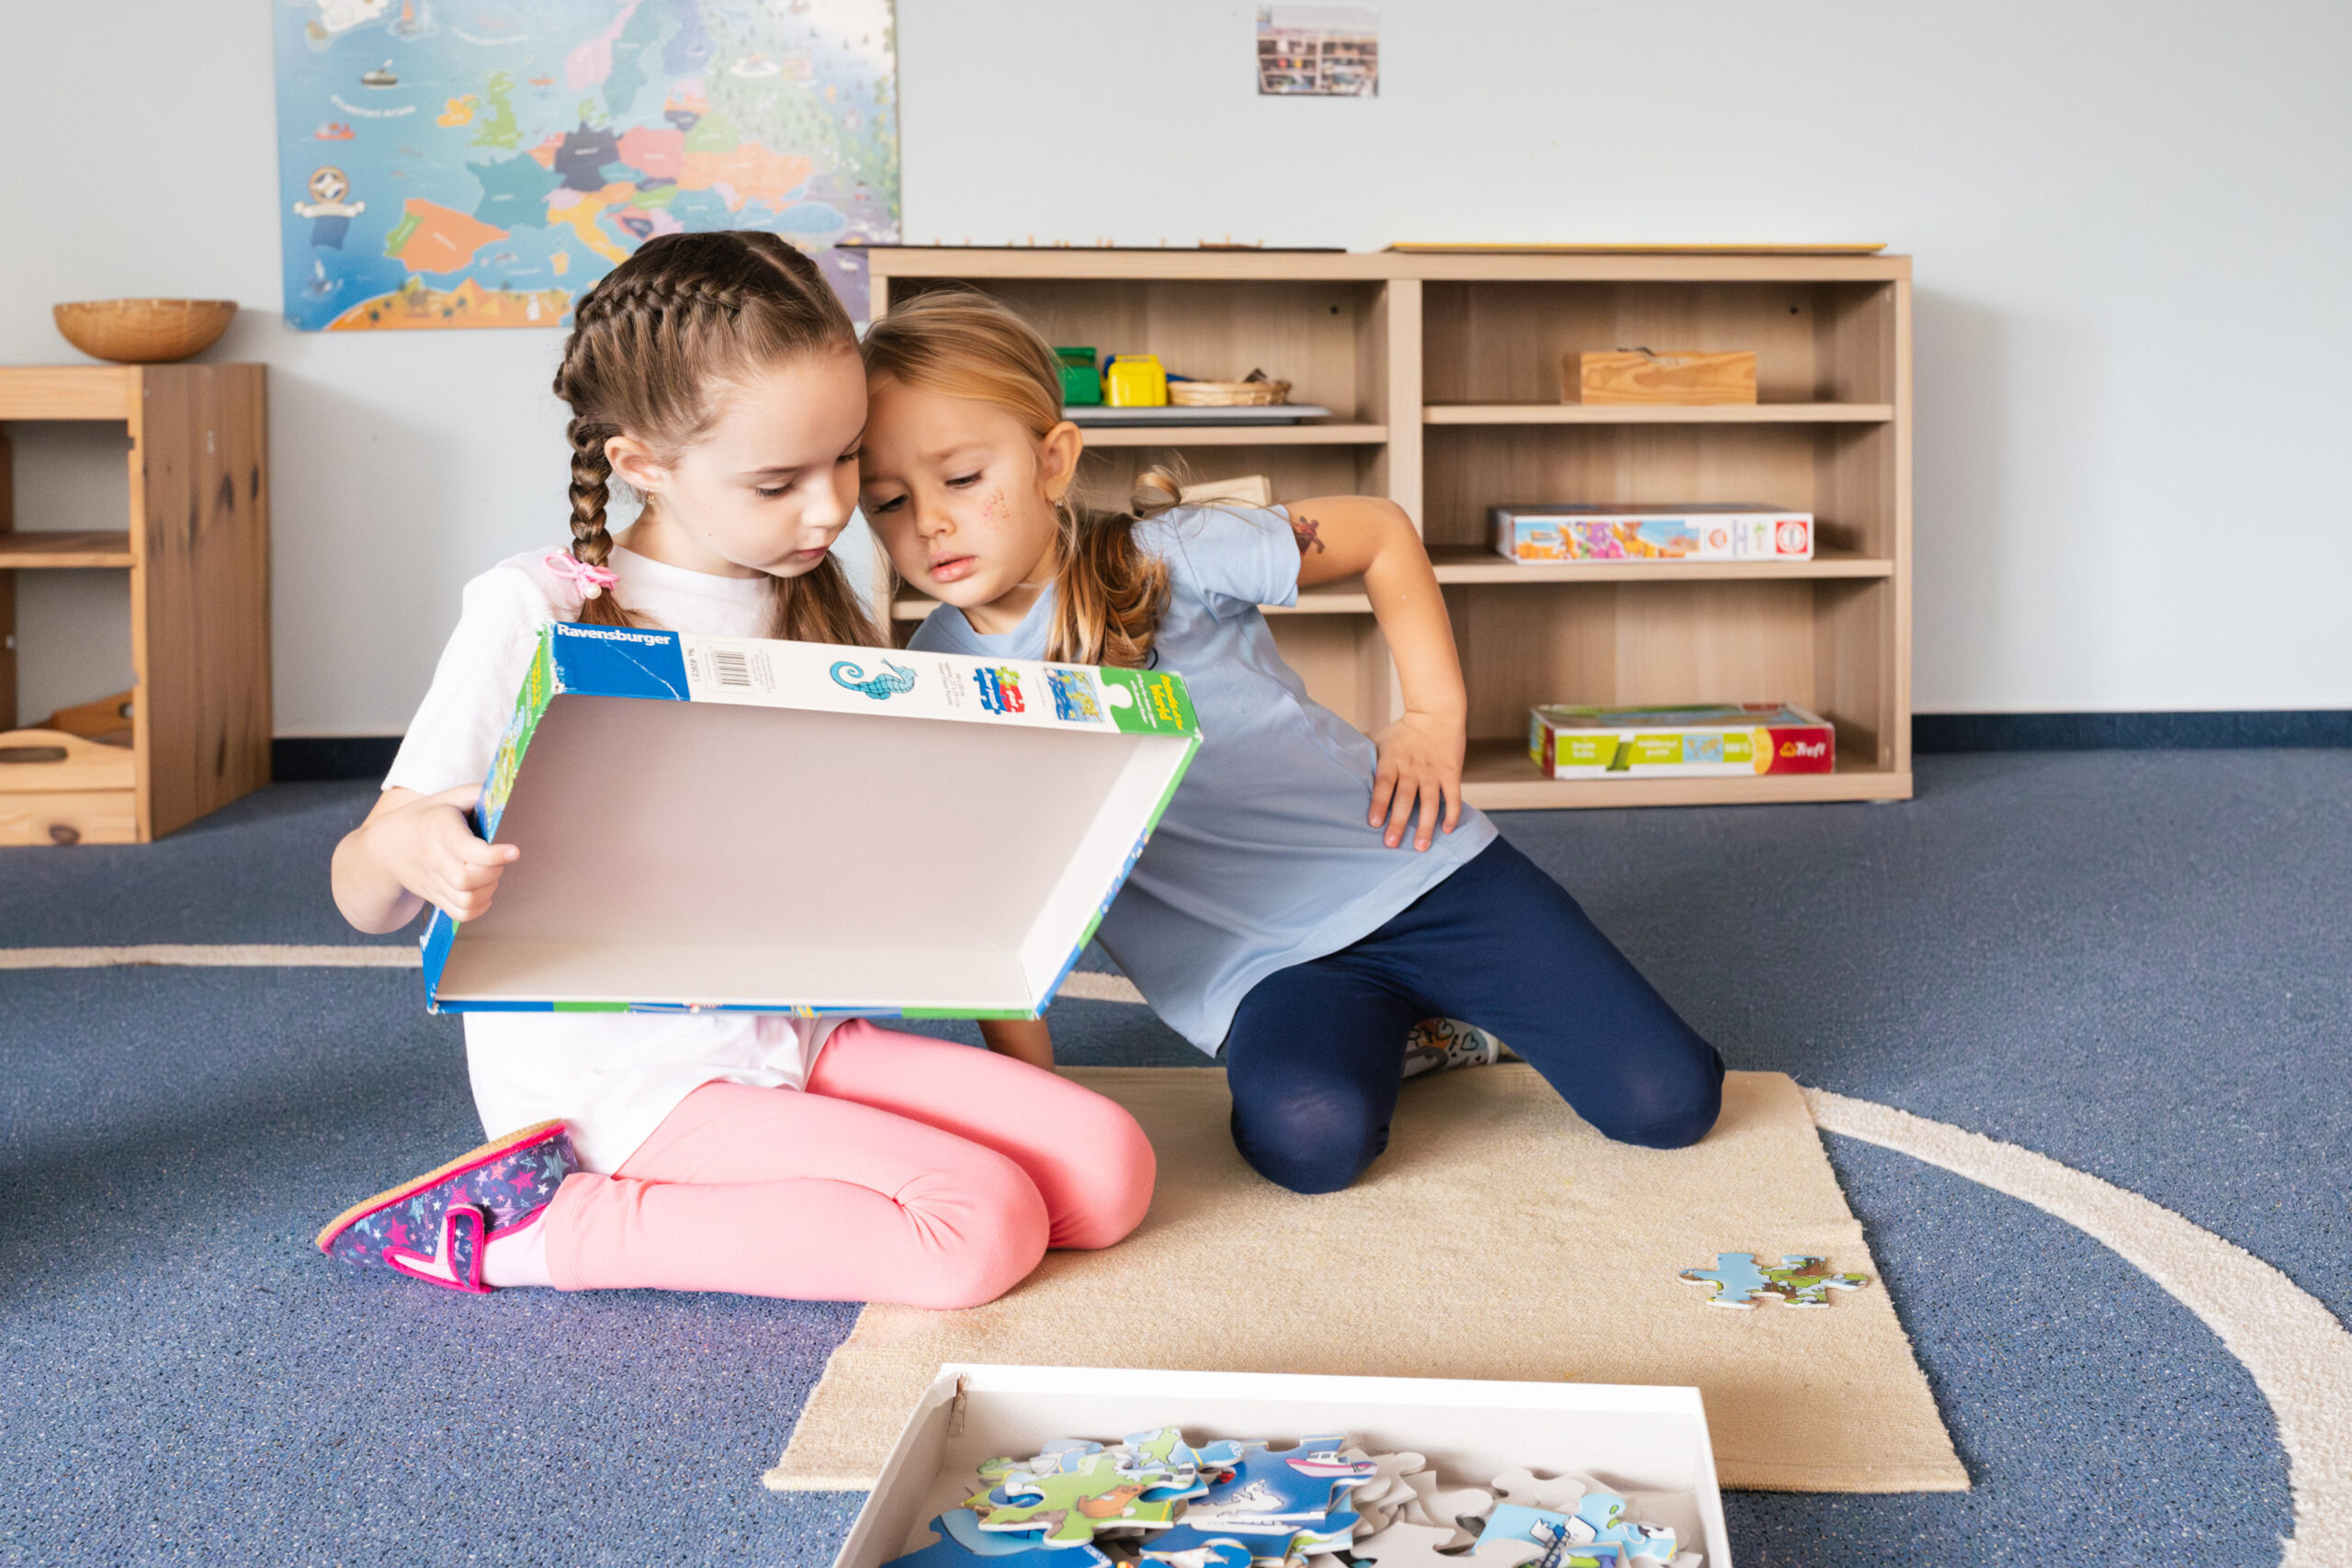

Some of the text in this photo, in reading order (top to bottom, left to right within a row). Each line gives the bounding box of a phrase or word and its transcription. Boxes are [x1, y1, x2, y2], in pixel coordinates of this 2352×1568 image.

[557, 624, 672, 647] Ravensburger
[1148, 683, 1173, 721] World
[1794, 741, 1826, 759] Trefl
